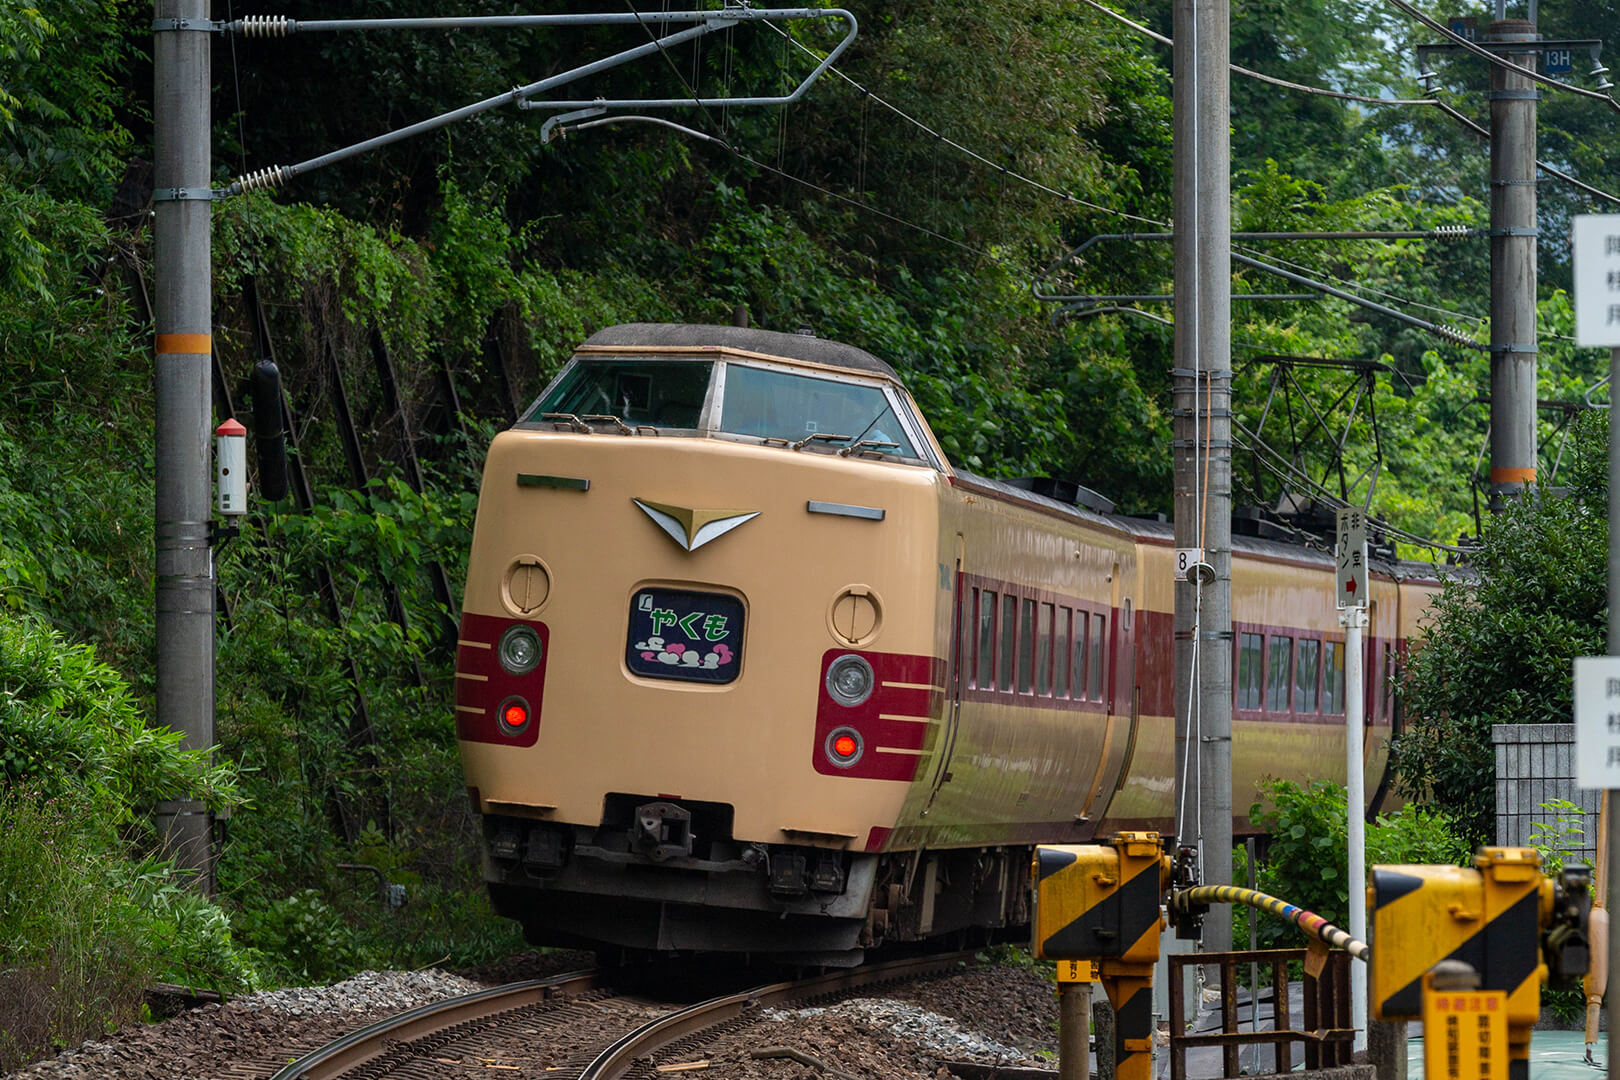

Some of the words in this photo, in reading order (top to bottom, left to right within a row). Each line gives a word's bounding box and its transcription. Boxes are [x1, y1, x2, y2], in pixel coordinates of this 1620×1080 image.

[1546, 51, 1570, 66] 13H
[1179, 552, 1187, 570] 8
[650, 608, 730, 641] やくも
